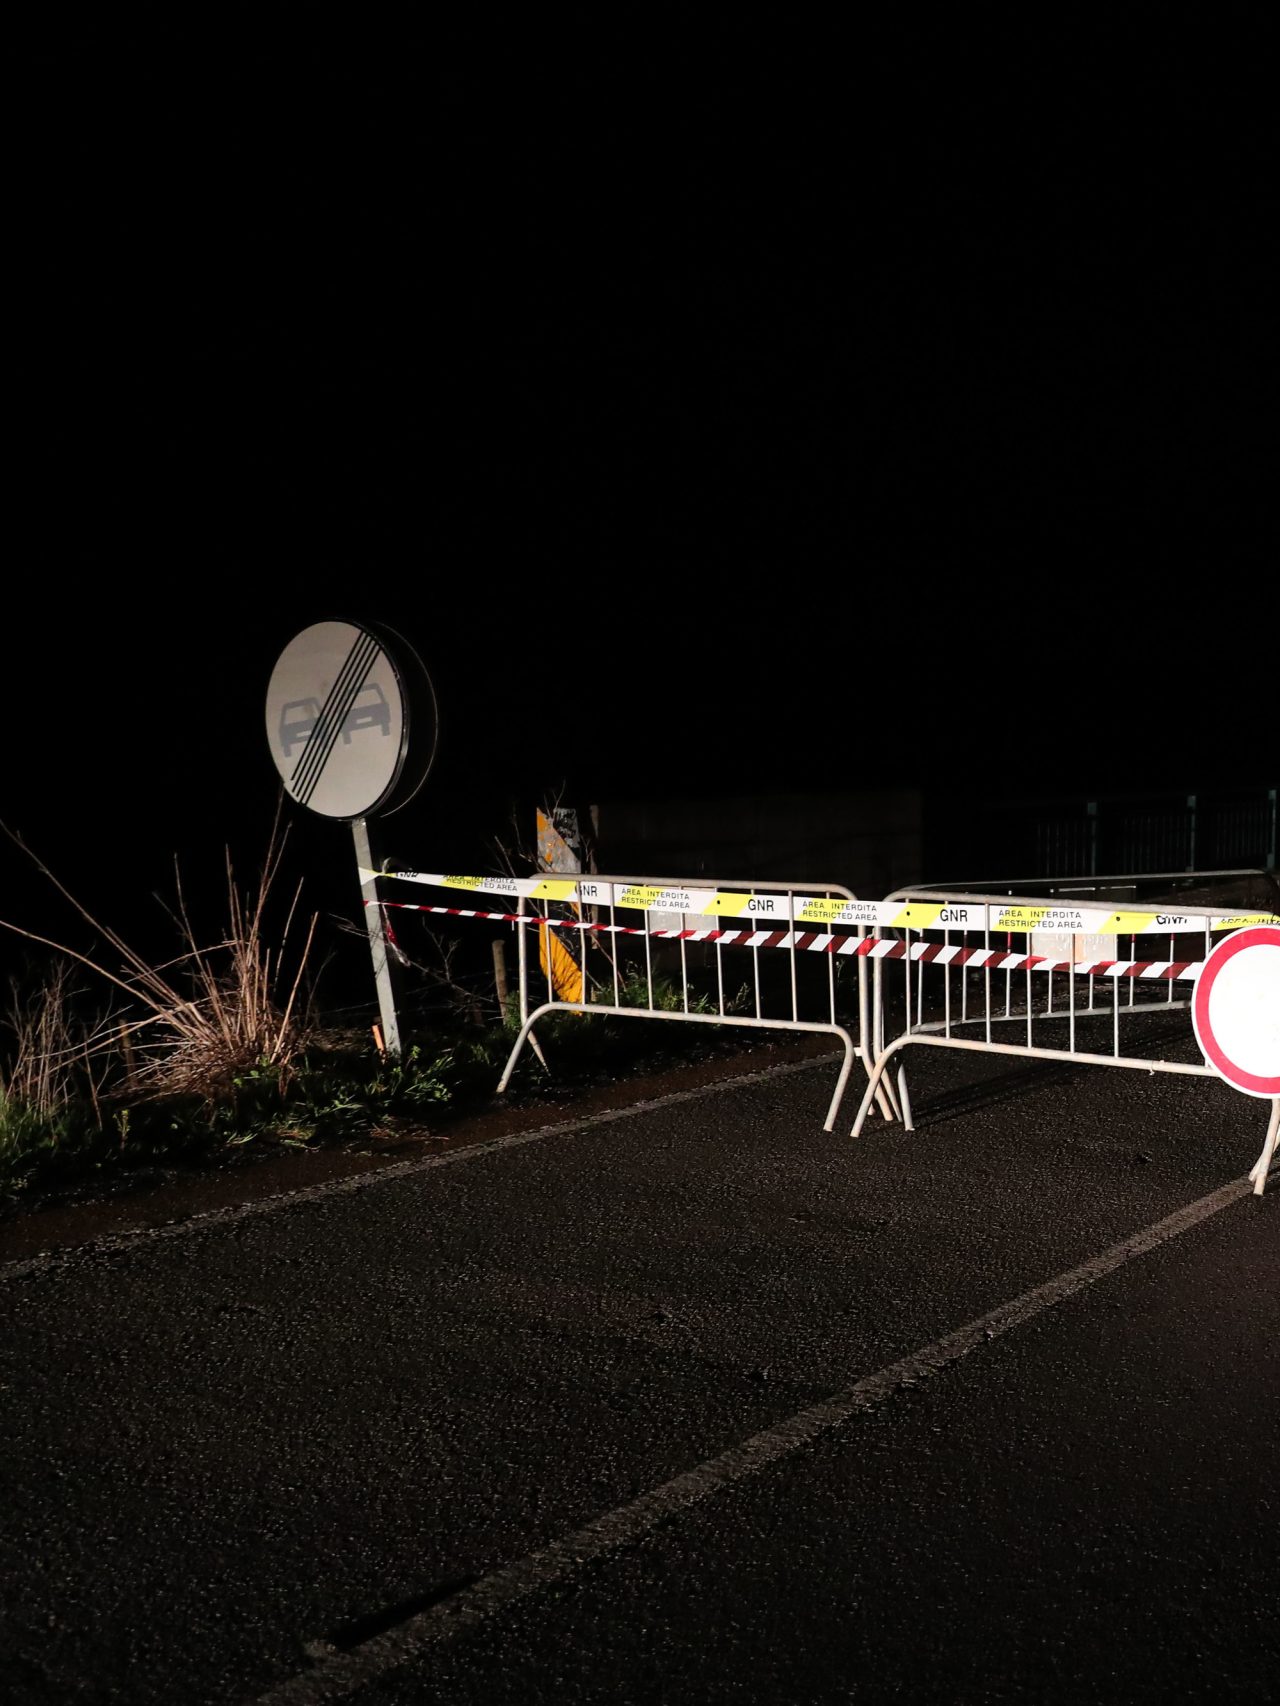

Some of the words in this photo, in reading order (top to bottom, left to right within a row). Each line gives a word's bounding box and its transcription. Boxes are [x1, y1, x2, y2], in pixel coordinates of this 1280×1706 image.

[647, 890, 690, 900] INTERDITA
[622, 896, 667, 907] RESTRICTED
[669, 901, 690, 909] AREA
[748, 898, 774, 912] GNR
[832, 902, 877, 911] INTERDITA
[803, 909, 853, 920] RESTRICTED
[855, 912, 878, 921] AREA
[940, 908, 968, 922] GNR
[1030, 911, 1081, 919] INTERDITA
[999, 919, 1054, 928] RESTRICTED
[1057, 921, 1083, 929] AREA
